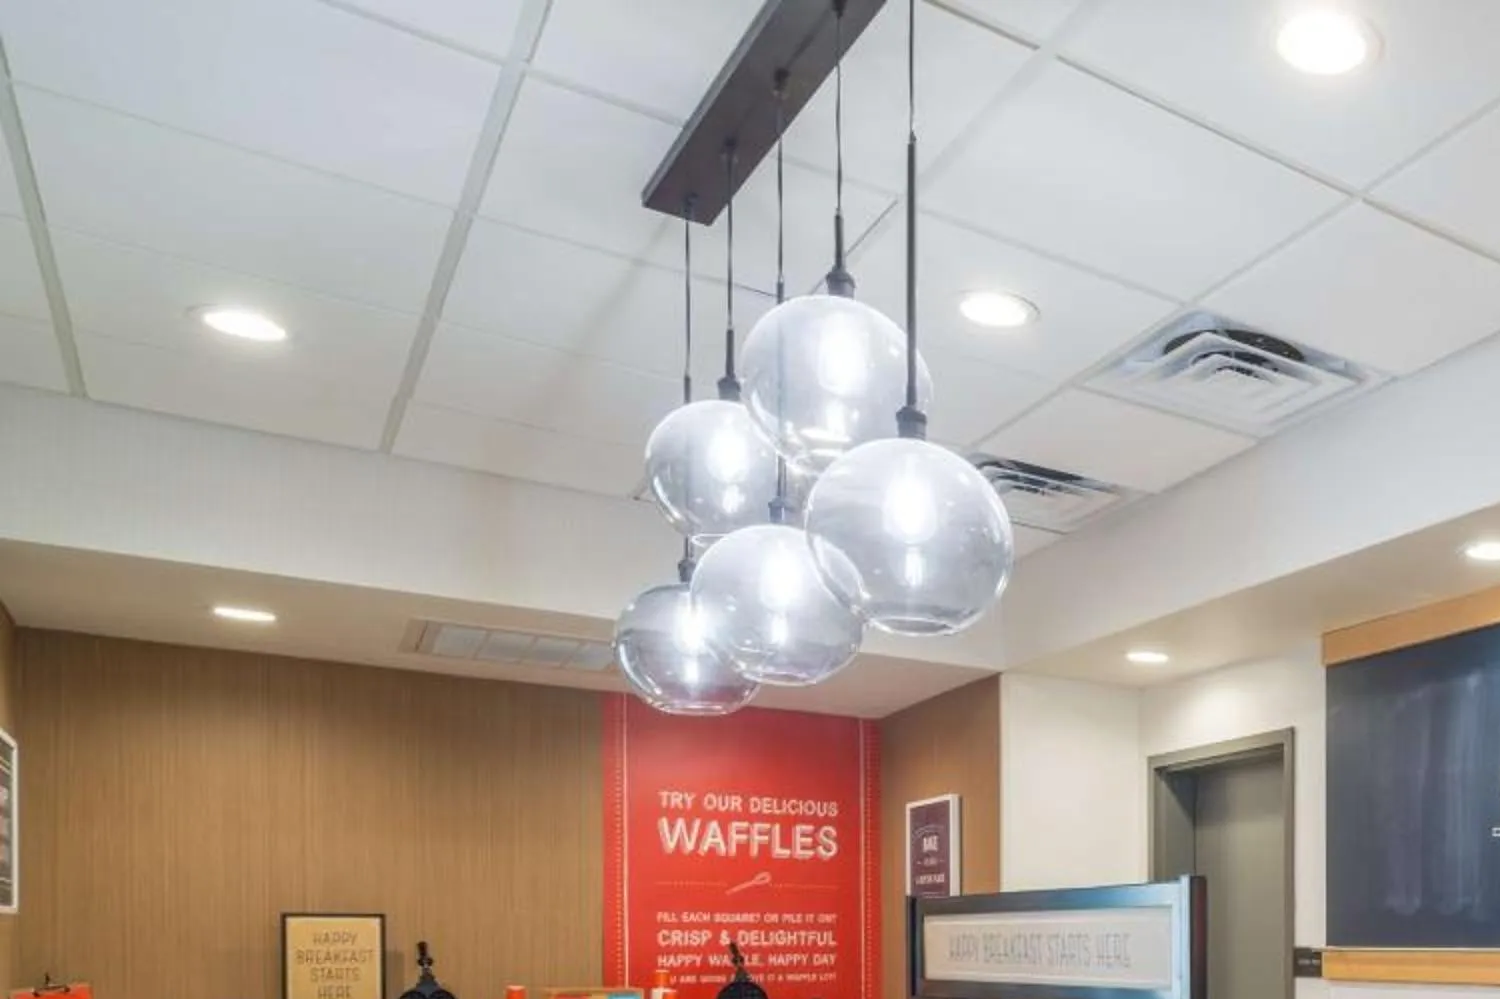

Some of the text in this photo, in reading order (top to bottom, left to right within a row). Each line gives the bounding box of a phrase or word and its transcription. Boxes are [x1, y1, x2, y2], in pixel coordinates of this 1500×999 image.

[658, 790, 839, 817] TRY OUR DELICIOUS
[657, 817, 838, 859] WAFFLES
[656, 911, 679, 923] FILL
[681, 911, 711, 923] EACH
[313, 931, 358, 946] HAPPY
[656, 929, 837, 947] CRISP & DELIGHTFUL
[657, 953, 837, 967] HAPPY WALE. HAPPY DAY
